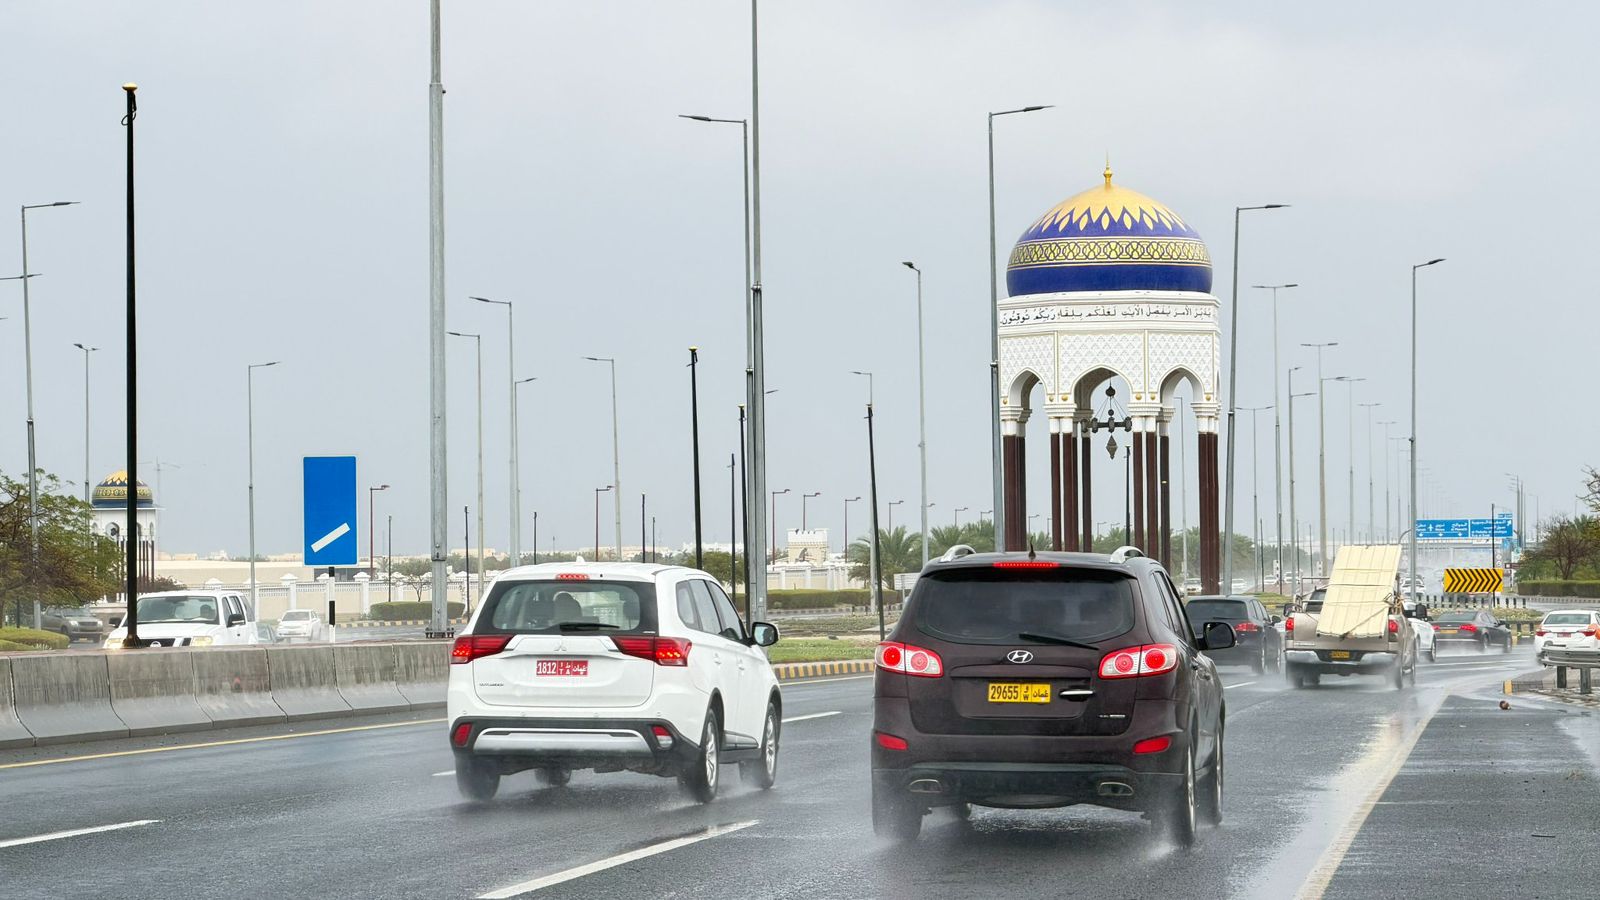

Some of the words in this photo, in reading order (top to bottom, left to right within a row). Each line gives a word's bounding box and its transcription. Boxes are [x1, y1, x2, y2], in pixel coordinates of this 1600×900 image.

[537, 662, 557, 674] 1812
[990, 685, 1019, 700] 29655
[1032, 688, 1049, 698] عمان
